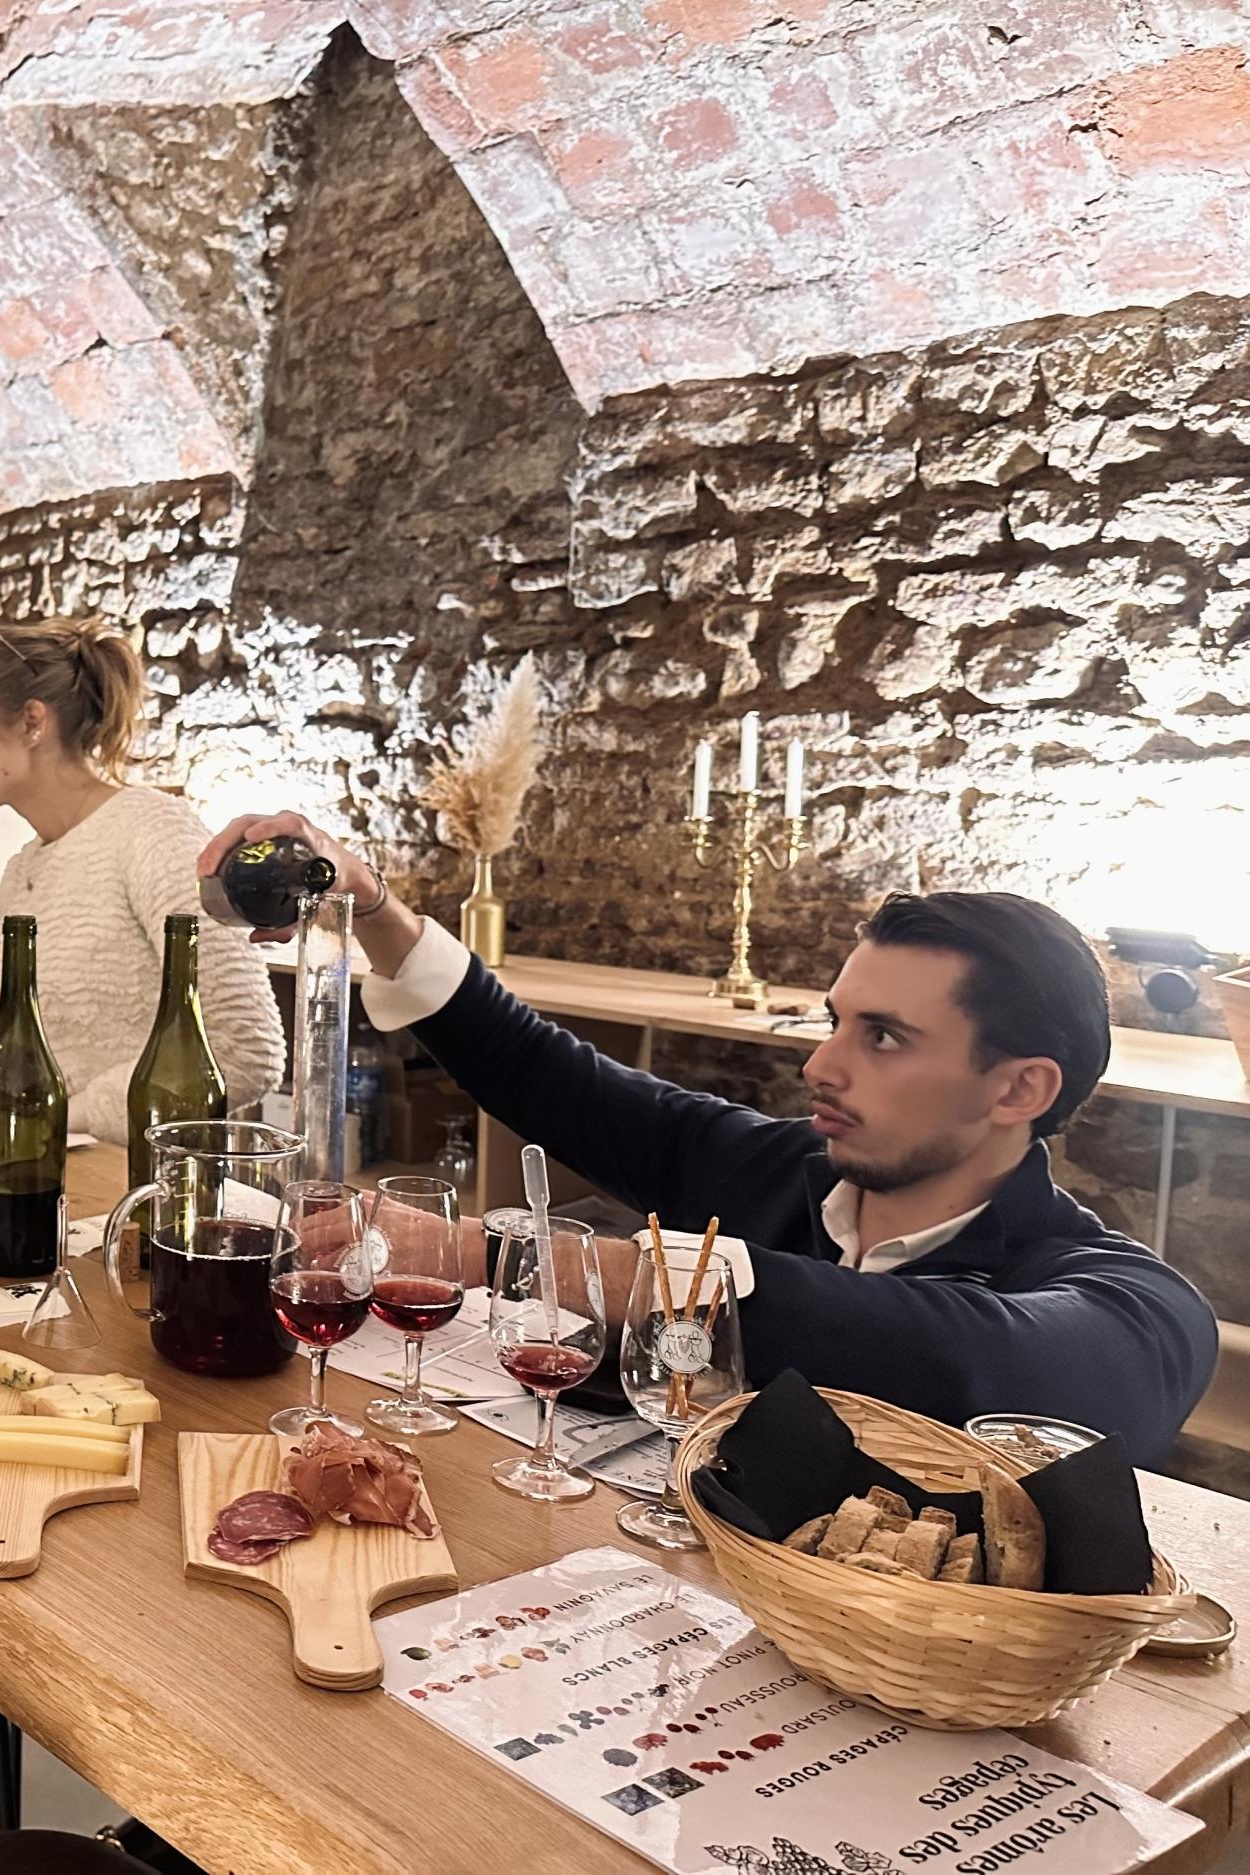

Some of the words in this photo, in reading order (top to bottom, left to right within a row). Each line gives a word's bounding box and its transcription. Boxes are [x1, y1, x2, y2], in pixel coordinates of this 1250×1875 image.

[553, 1577, 634, 1612] SAVAGNIN
[633, 1574, 654, 1585] LE
[568, 1601, 675, 1645] CHARDONNAY
[632, 1626, 708, 1660] CÉPAGES
[717, 1646, 766, 1669] PINOT
[562, 1656, 633, 1687] BLANCS
[672, 1664, 719, 1686] NOIR
[720, 1672, 811, 1714] ROUSSEAU
[781, 1698, 858, 1735] OULSARD
[828, 1724, 909, 1765] CÉPAGES
[754, 1760, 833, 1799] ROUGES
[918, 1753, 1030, 1812] cépages
[950, 1771, 1078, 1837] typiques
[1057, 1791, 1122, 1824] Les
[898, 1830, 962, 1865] des
[955, 1816, 1066, 1875] arômes
